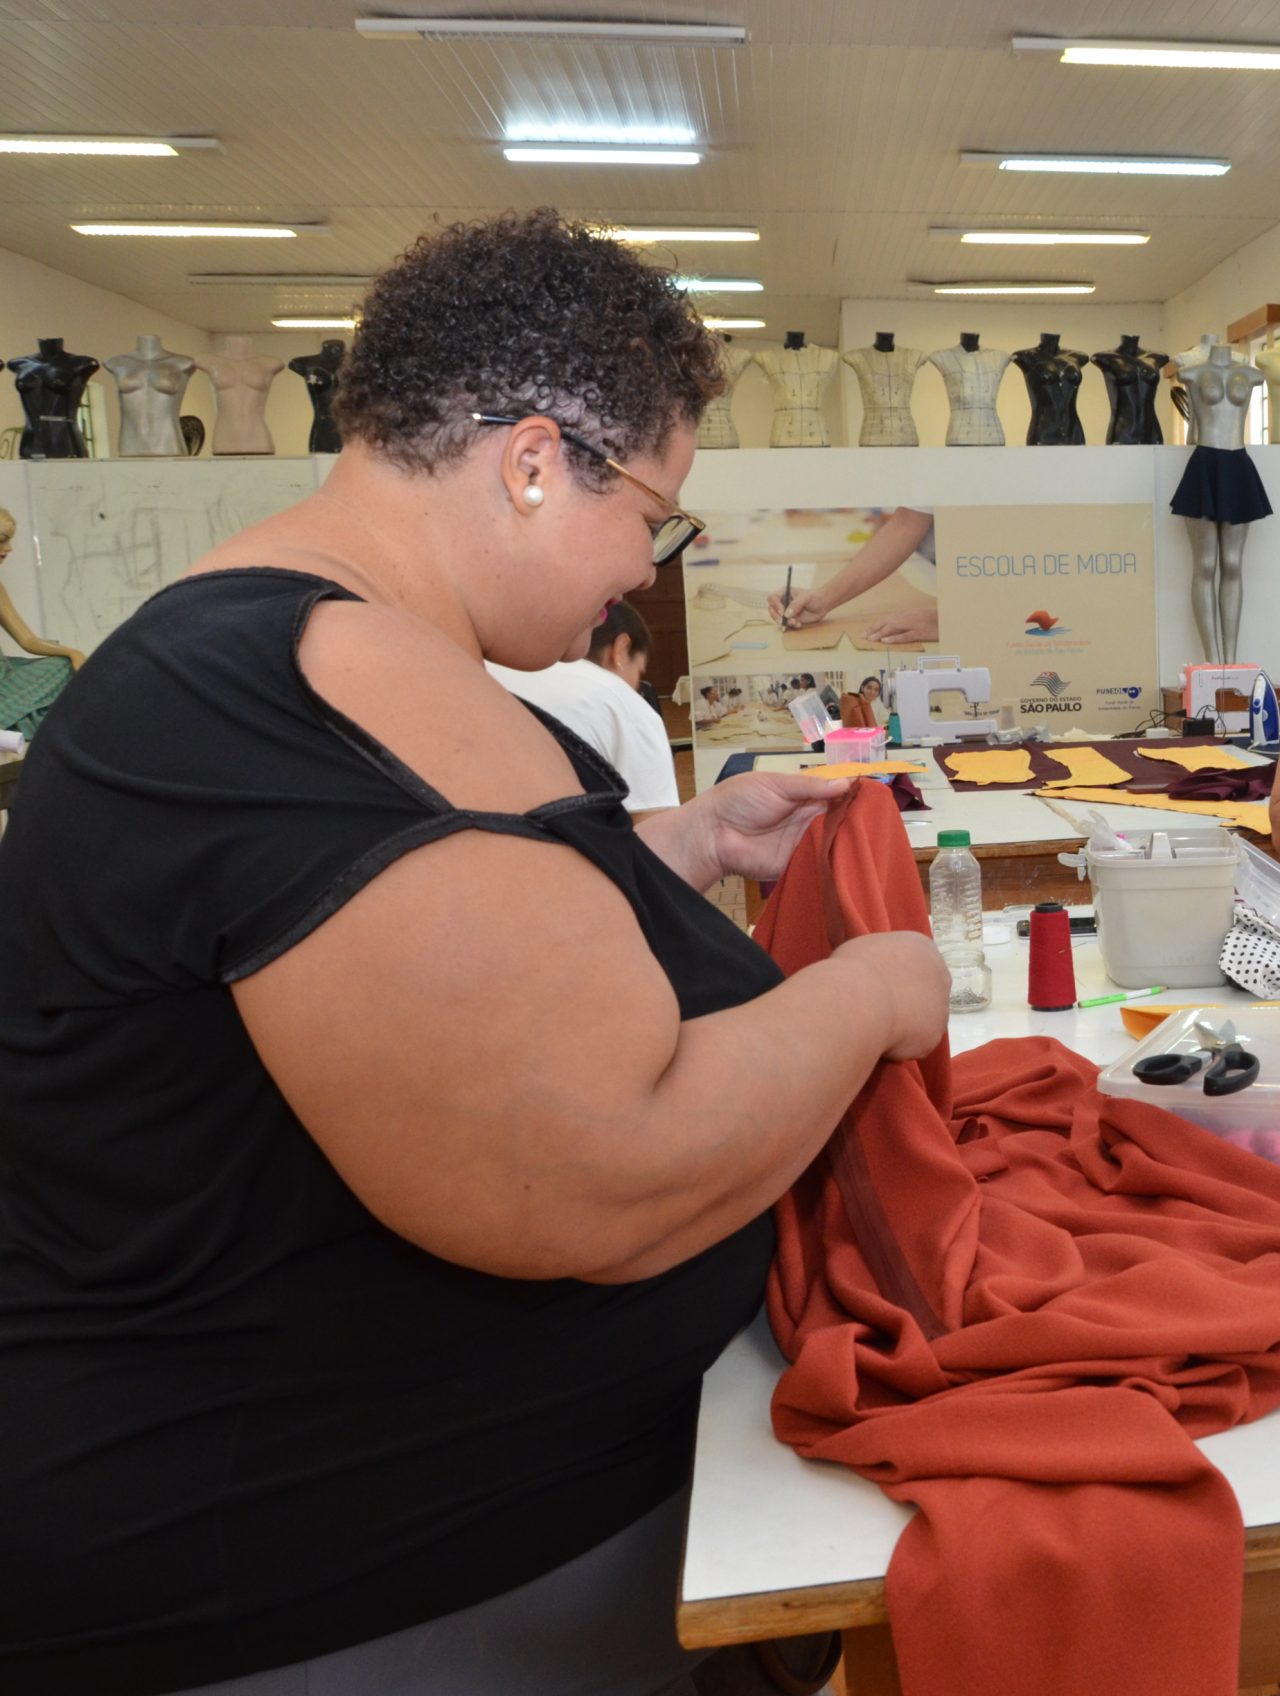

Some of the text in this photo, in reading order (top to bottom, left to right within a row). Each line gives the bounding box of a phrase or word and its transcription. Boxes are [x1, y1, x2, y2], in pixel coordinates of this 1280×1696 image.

[955, 552, 1137, 578] ESCOLA DE MODA
[1020, 702, 1082, 713] SÃO PAULO
